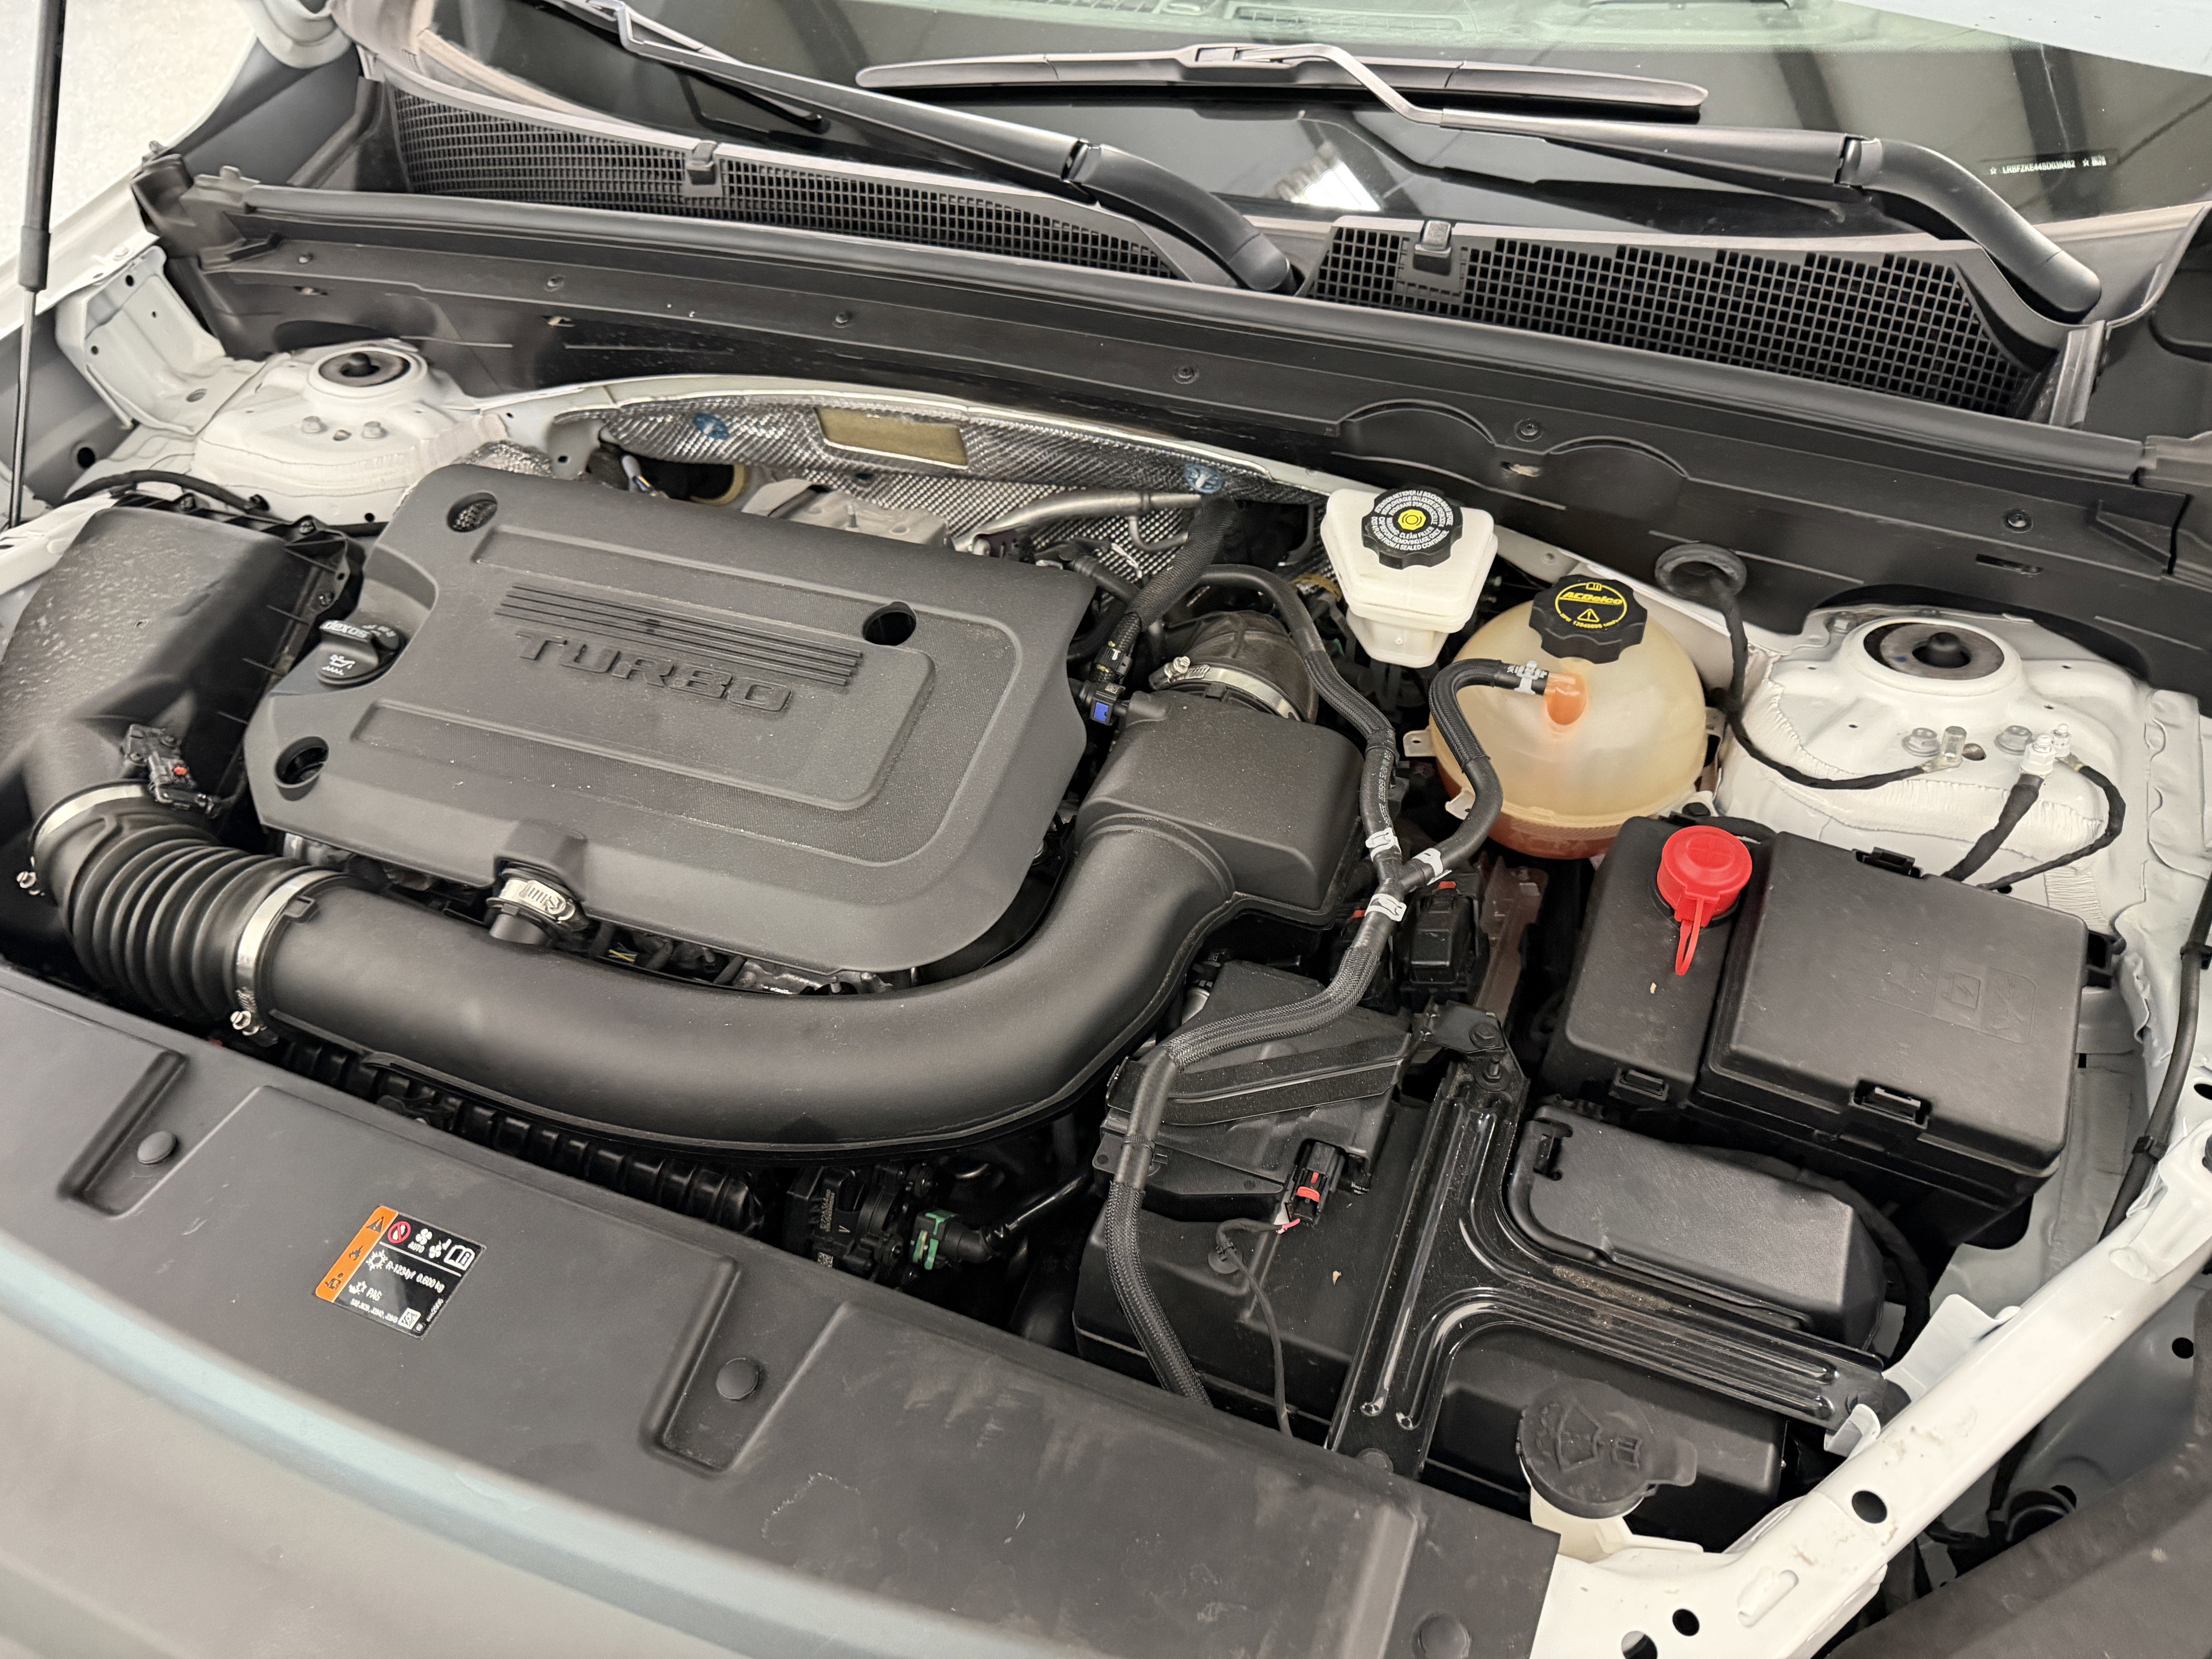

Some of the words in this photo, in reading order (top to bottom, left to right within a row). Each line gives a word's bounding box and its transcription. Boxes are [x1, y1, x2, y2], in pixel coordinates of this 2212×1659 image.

[1381, 537, 1396, 548] FROM
[1562, 591, 1623, 605] ACDelco
[323, 620, 371, 638] dexos
[516, 632, 792, 712] TURBO
[408, 1241, 425, 1254] AUTO
[366, 1287, 382, 1301] PAG
